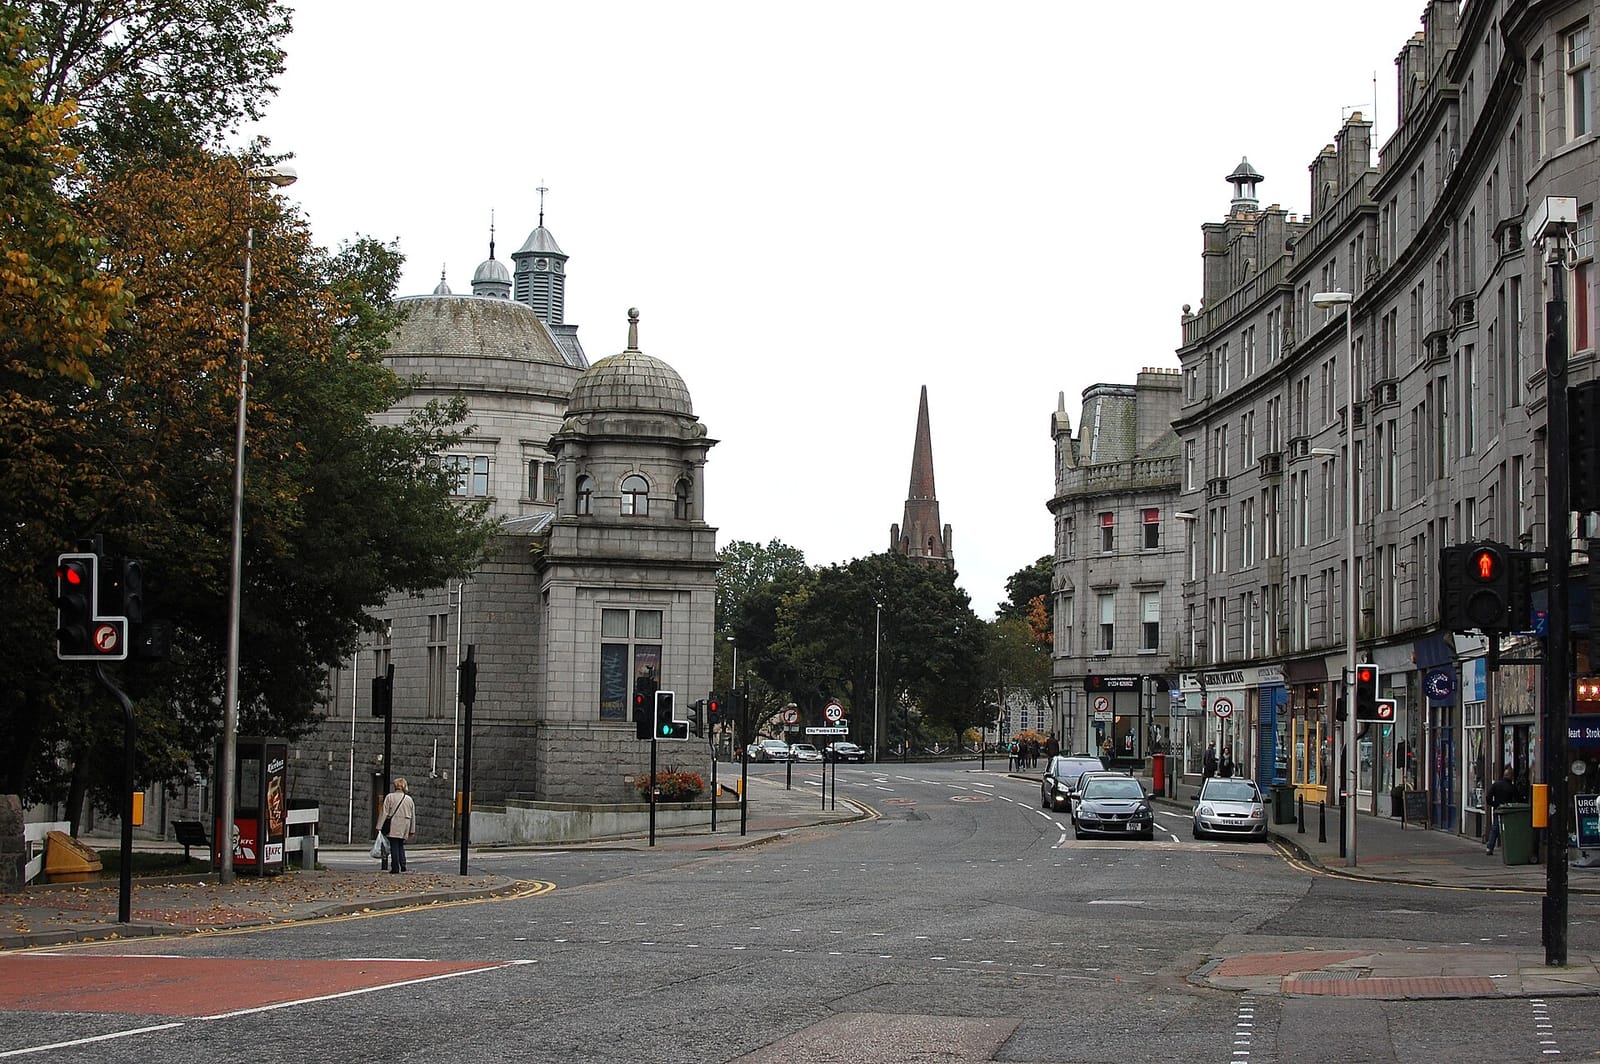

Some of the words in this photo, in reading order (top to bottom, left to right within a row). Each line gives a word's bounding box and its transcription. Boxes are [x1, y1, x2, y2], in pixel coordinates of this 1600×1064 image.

[827, 708, 840, 717] 20
[1217, 704, 1229, 713] 20
[270, 846, 282, 855] KFC
